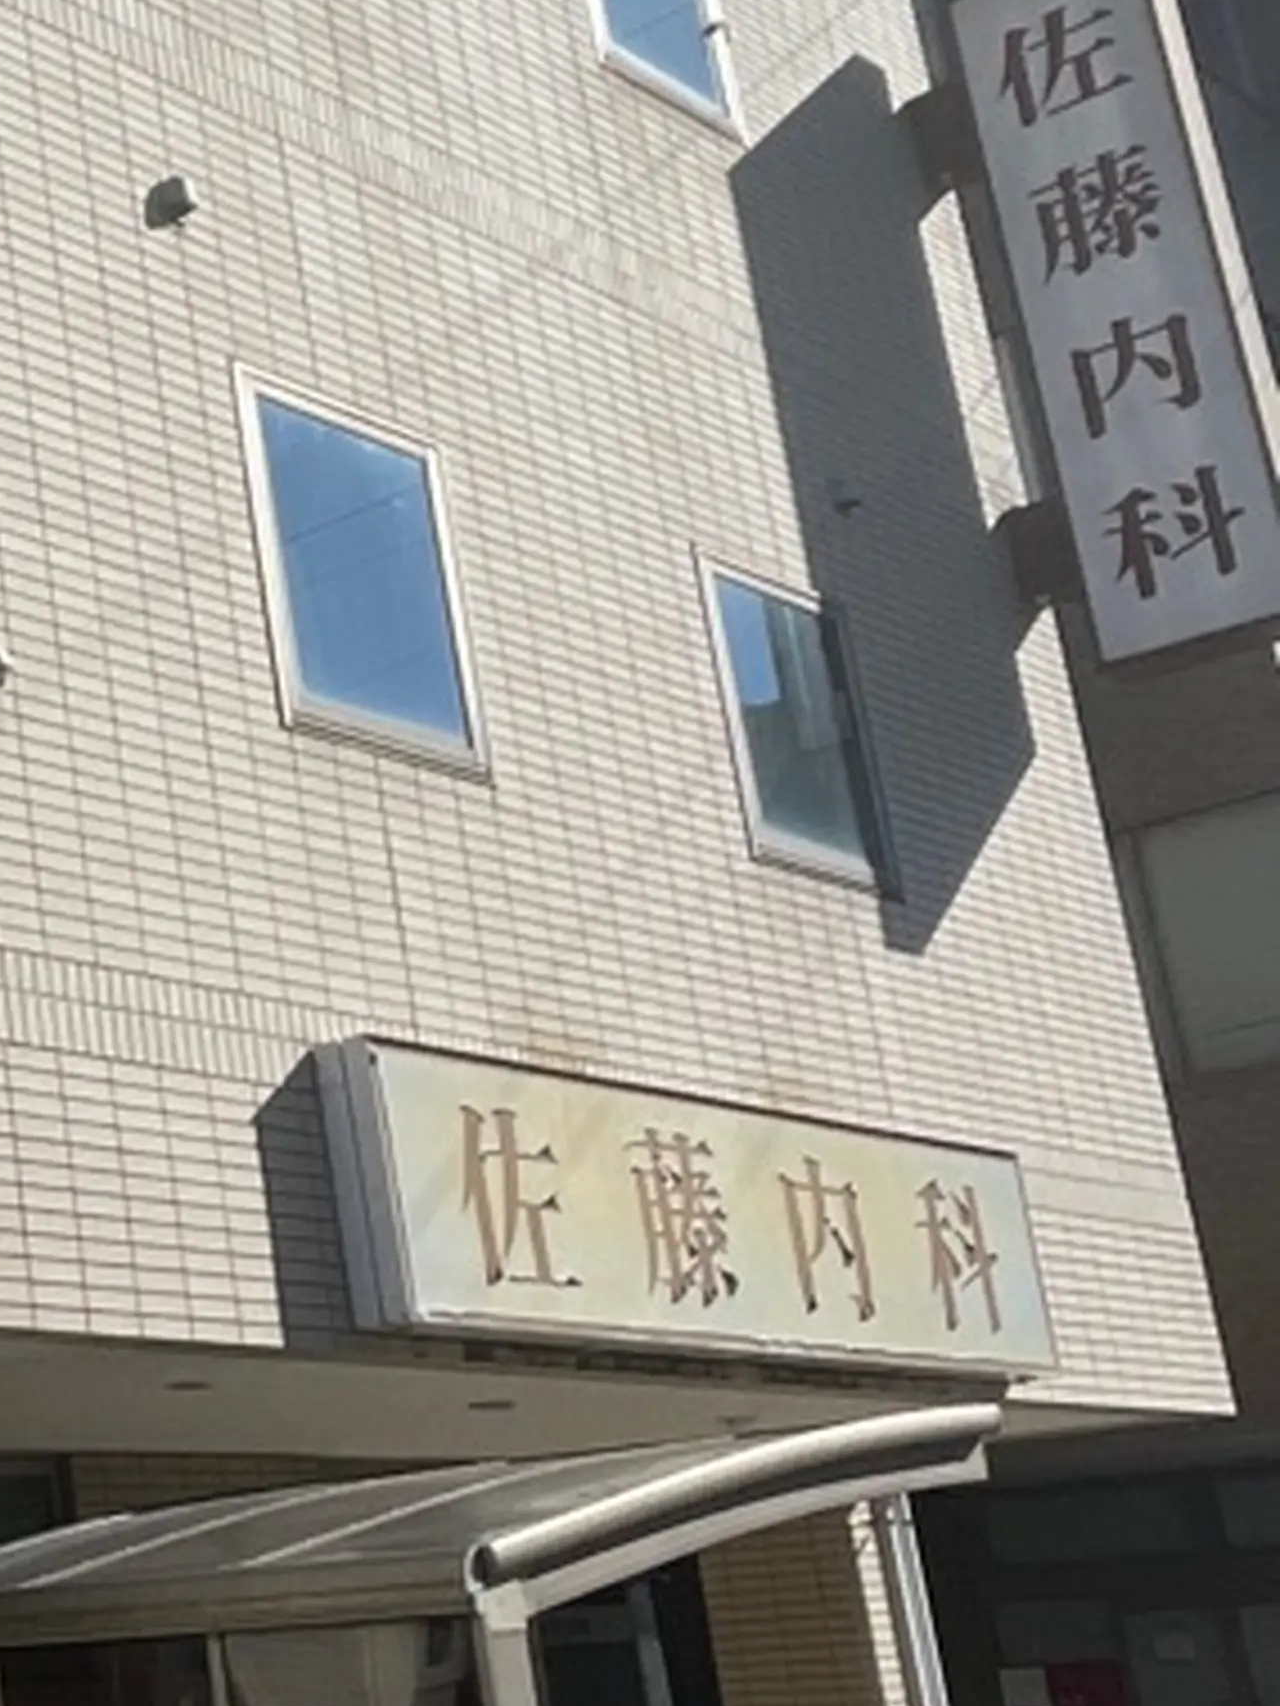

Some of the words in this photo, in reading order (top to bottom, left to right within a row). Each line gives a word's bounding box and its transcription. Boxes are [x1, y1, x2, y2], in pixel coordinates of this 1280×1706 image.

[998, 4, 1245, 602] 佐藤内科
[459, 1103, 1003, 1335] 佐藤内科
